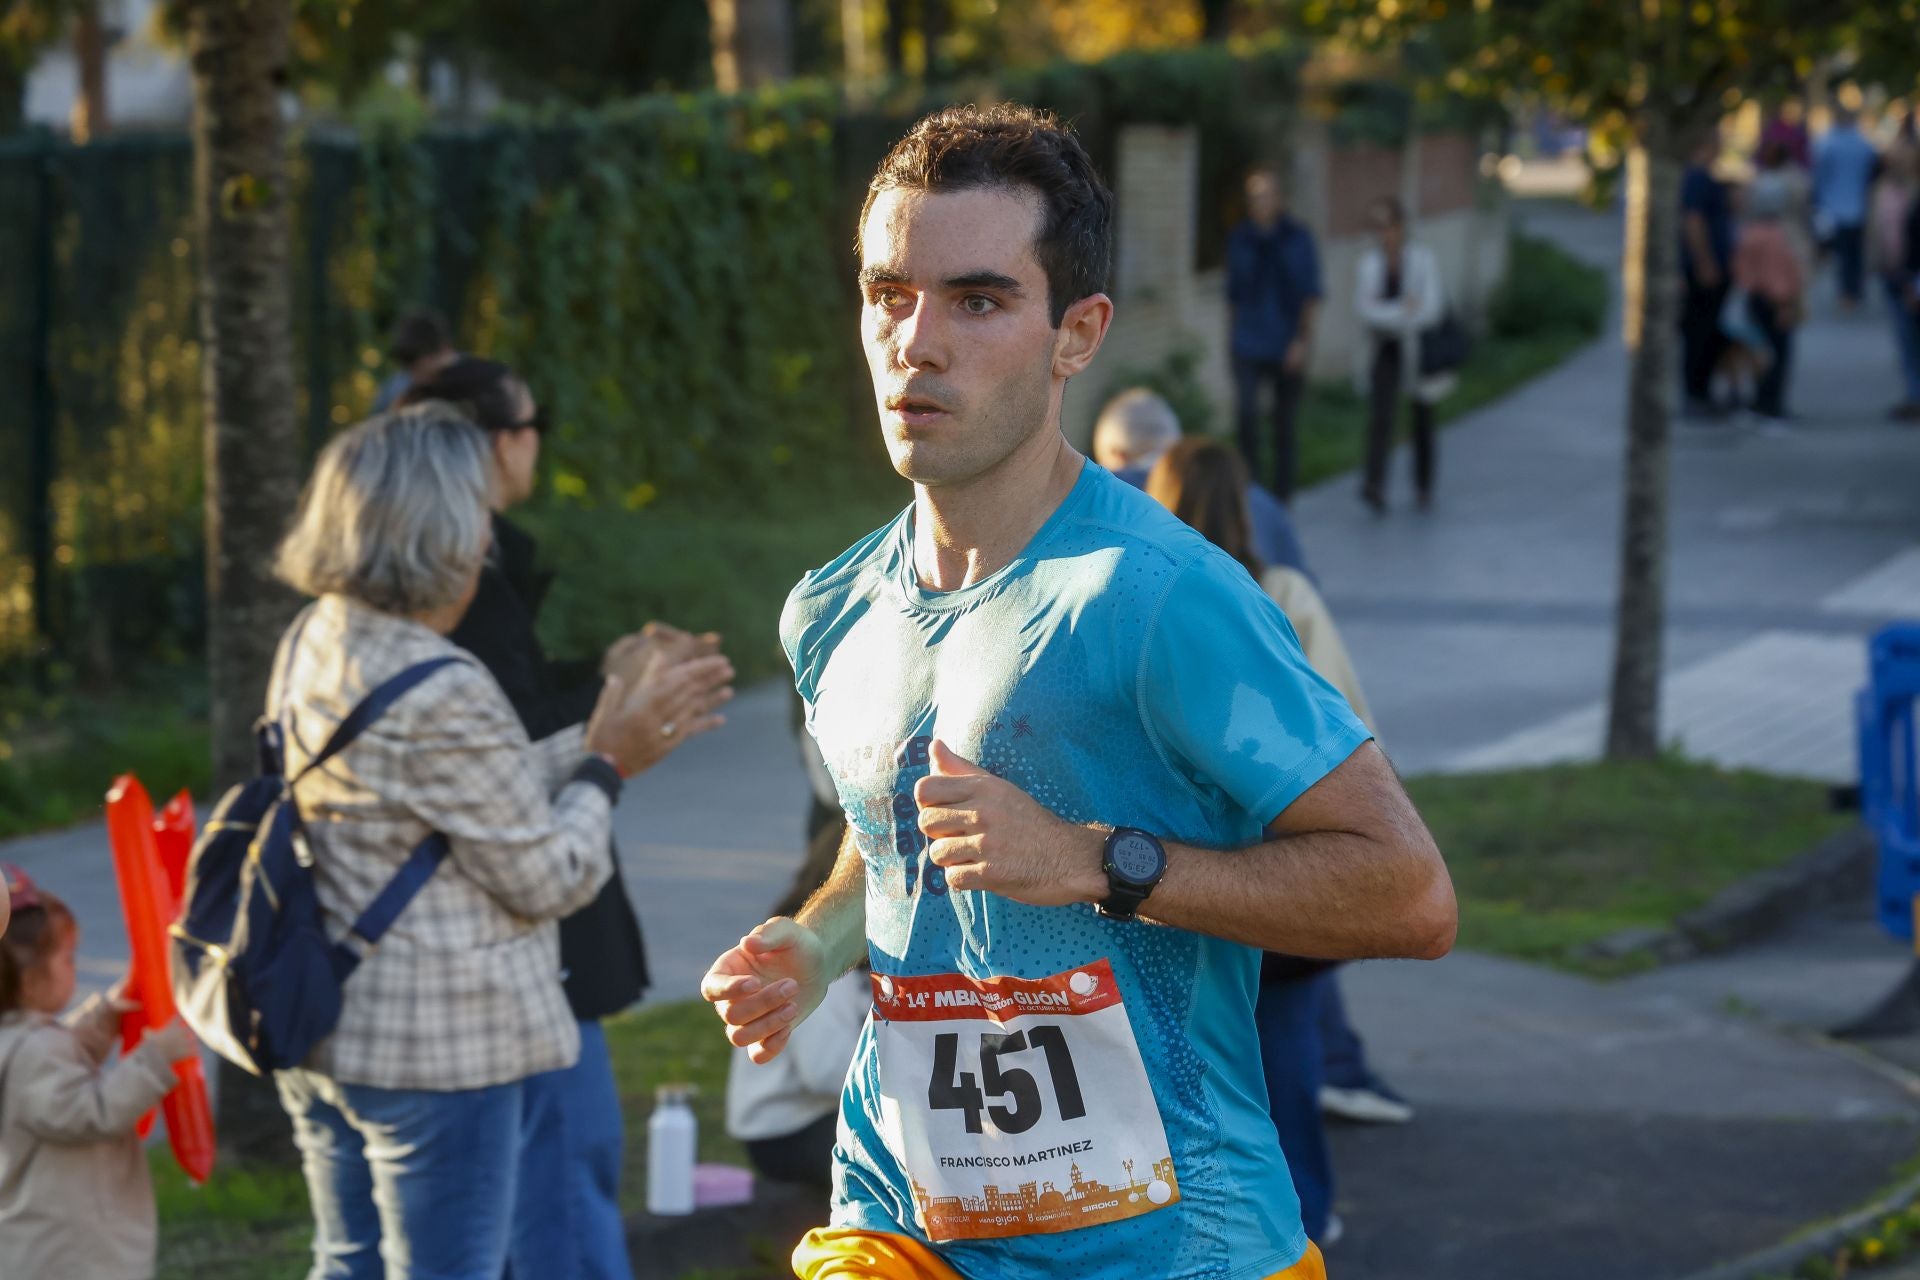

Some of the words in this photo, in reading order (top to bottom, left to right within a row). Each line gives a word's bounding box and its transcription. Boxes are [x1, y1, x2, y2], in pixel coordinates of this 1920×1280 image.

[905, 991, 930, 1008] 14ª
[934, 989, 982, 1008] MBA
[1013, 990, 1070, 1006] GIJÓN
[928, 1025, 1087, 1135] 451
[940, 1156, 1011, 1168] FRANCISCO
[1013, 1139, 1094, 1167] MARTINEZ
[1081, 1199, 1119, 1213] SIROKO
[995, 1214, 1020, 1226] gijón
